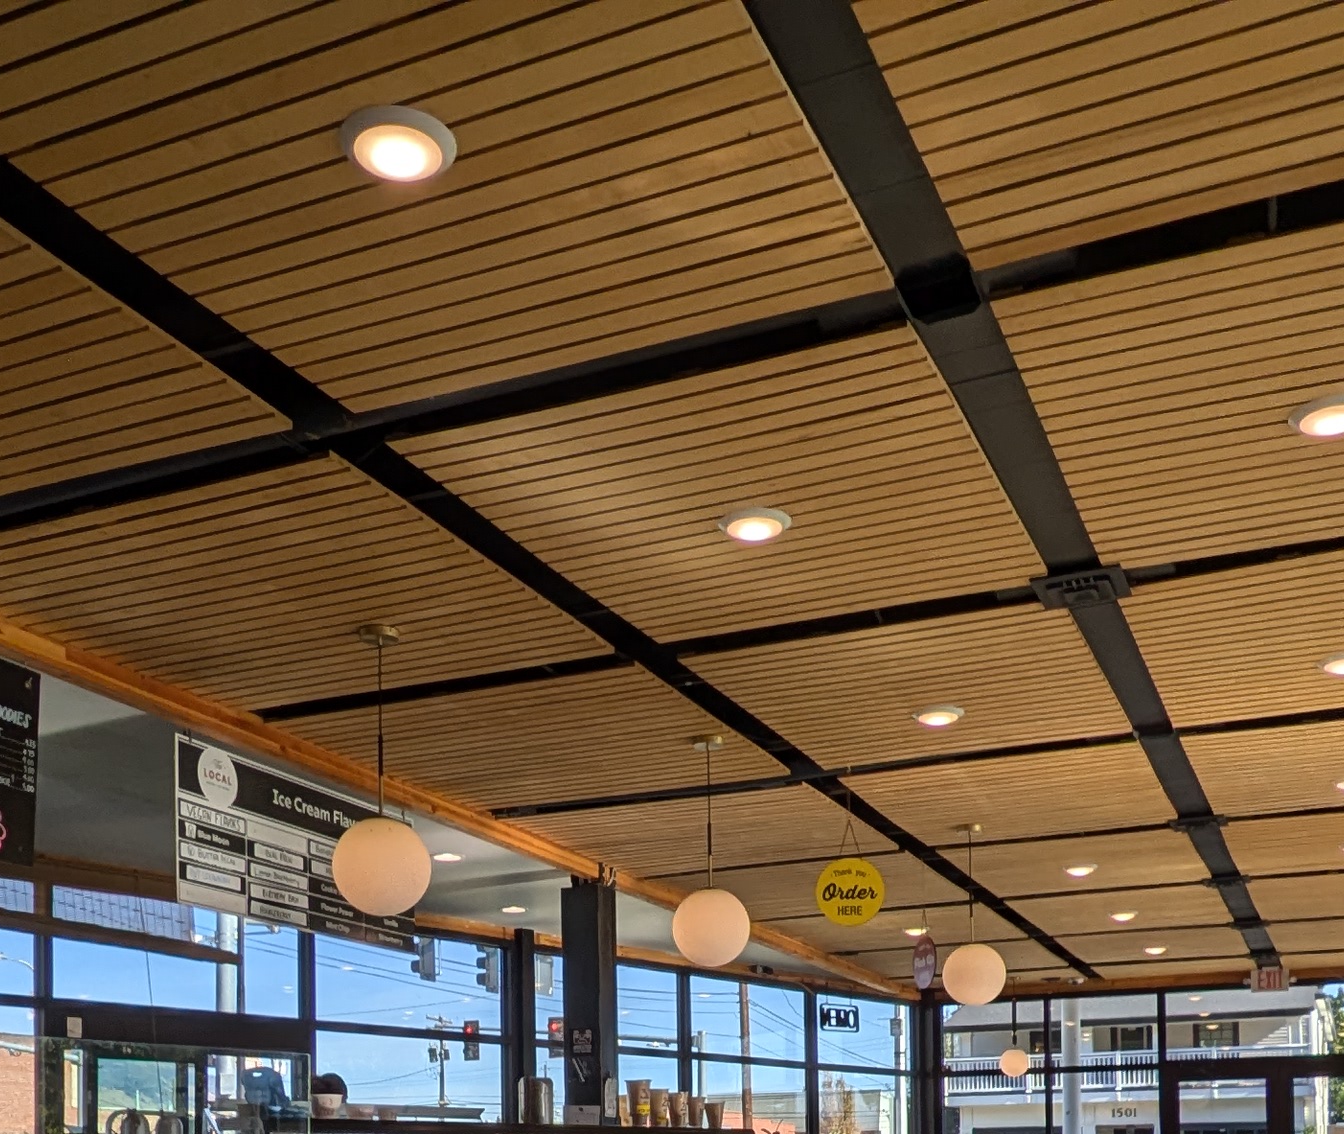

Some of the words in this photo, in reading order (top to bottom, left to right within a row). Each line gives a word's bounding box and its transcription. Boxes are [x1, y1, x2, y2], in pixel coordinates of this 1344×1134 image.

[203, 767, 232, 786] LOCAL
[186, 803, 212, 823] VEGAN
[272, 788, 292, 809] Ice
[294, 798, 331, 822] Cream
[333, 811, 358, 828] Flav
[822, 883, 878, 901] Order
[838, 906, 862, 915] HERE
[1258, 970, 1282, 989] EXIT
[1112, 1108, 1136, 1117] 1501
